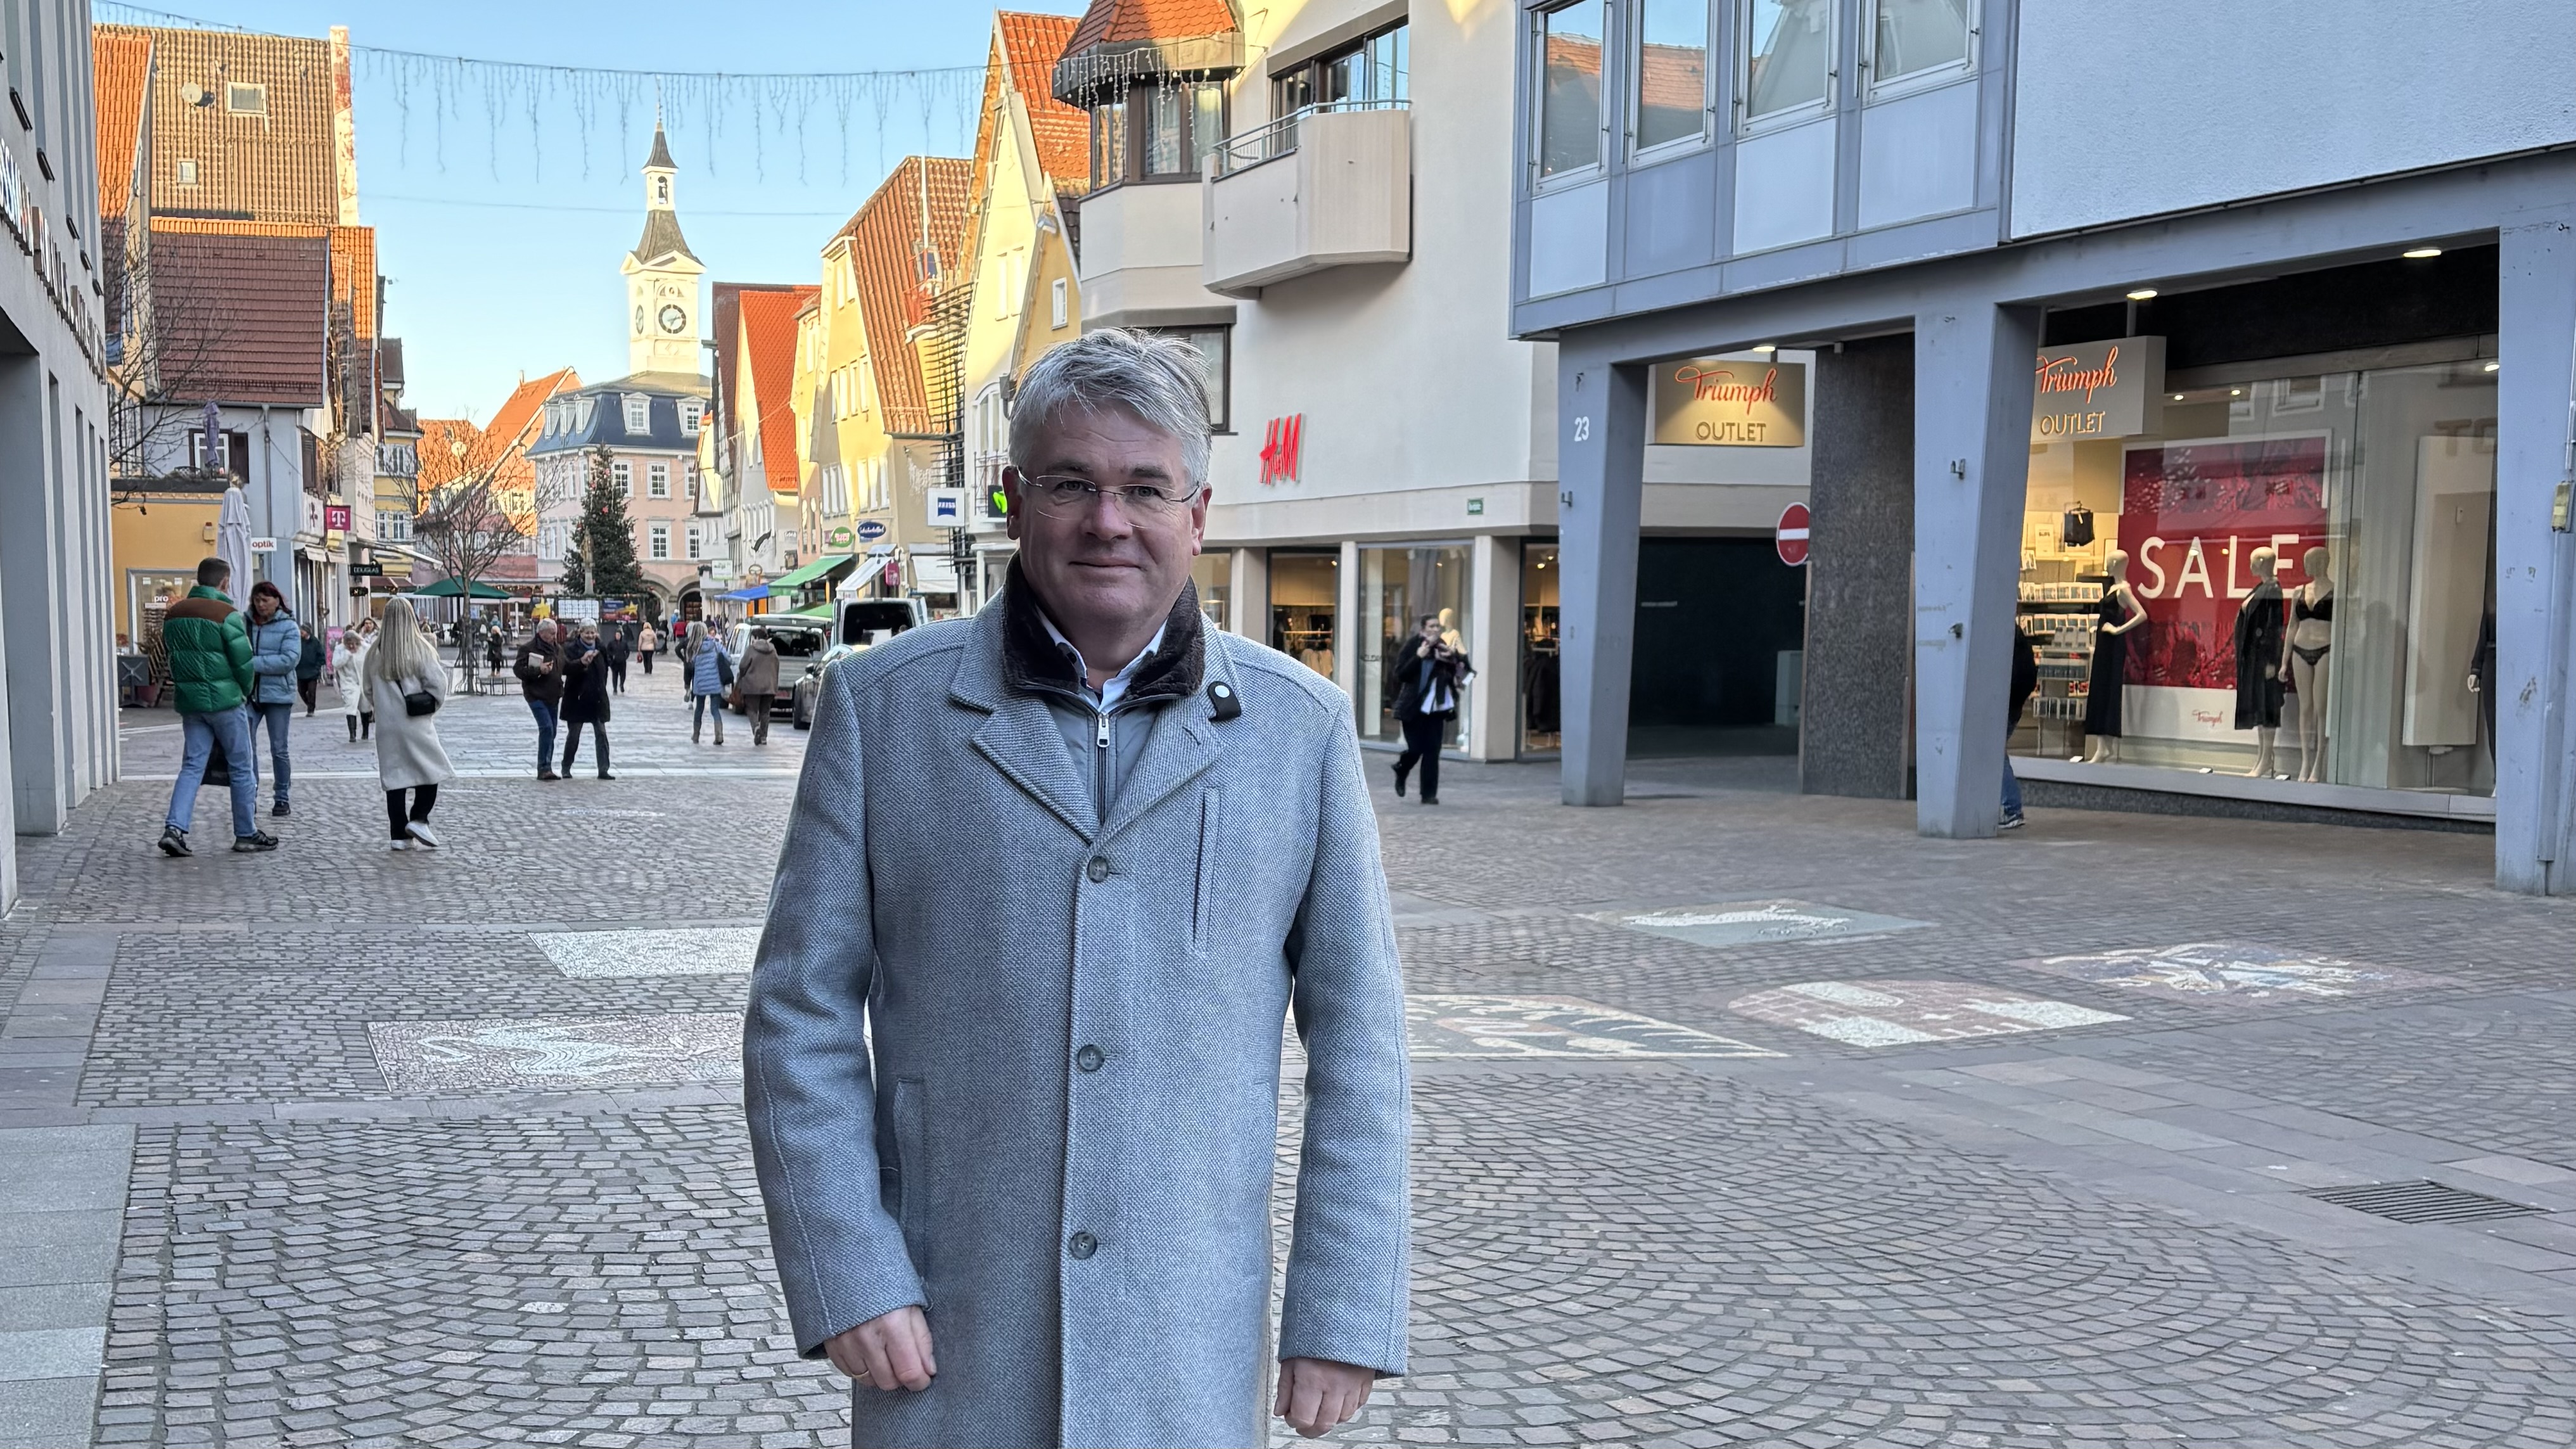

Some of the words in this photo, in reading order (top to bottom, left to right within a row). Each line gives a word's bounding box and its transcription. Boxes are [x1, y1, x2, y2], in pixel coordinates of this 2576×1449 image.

[2036, 345, 2118, 404] Triumph
[1674, 365, 1778, 416] Triumph
[1574, 416, 1590, 442] 23
[1695, 421, 1766, 442] OUTLET
[2041, 411, 2105, 435] OUTLET
[331, 511, 346, 527] T
[252, 540, 274, 549] optik
[2137, 533, 2300, 598] SALE
